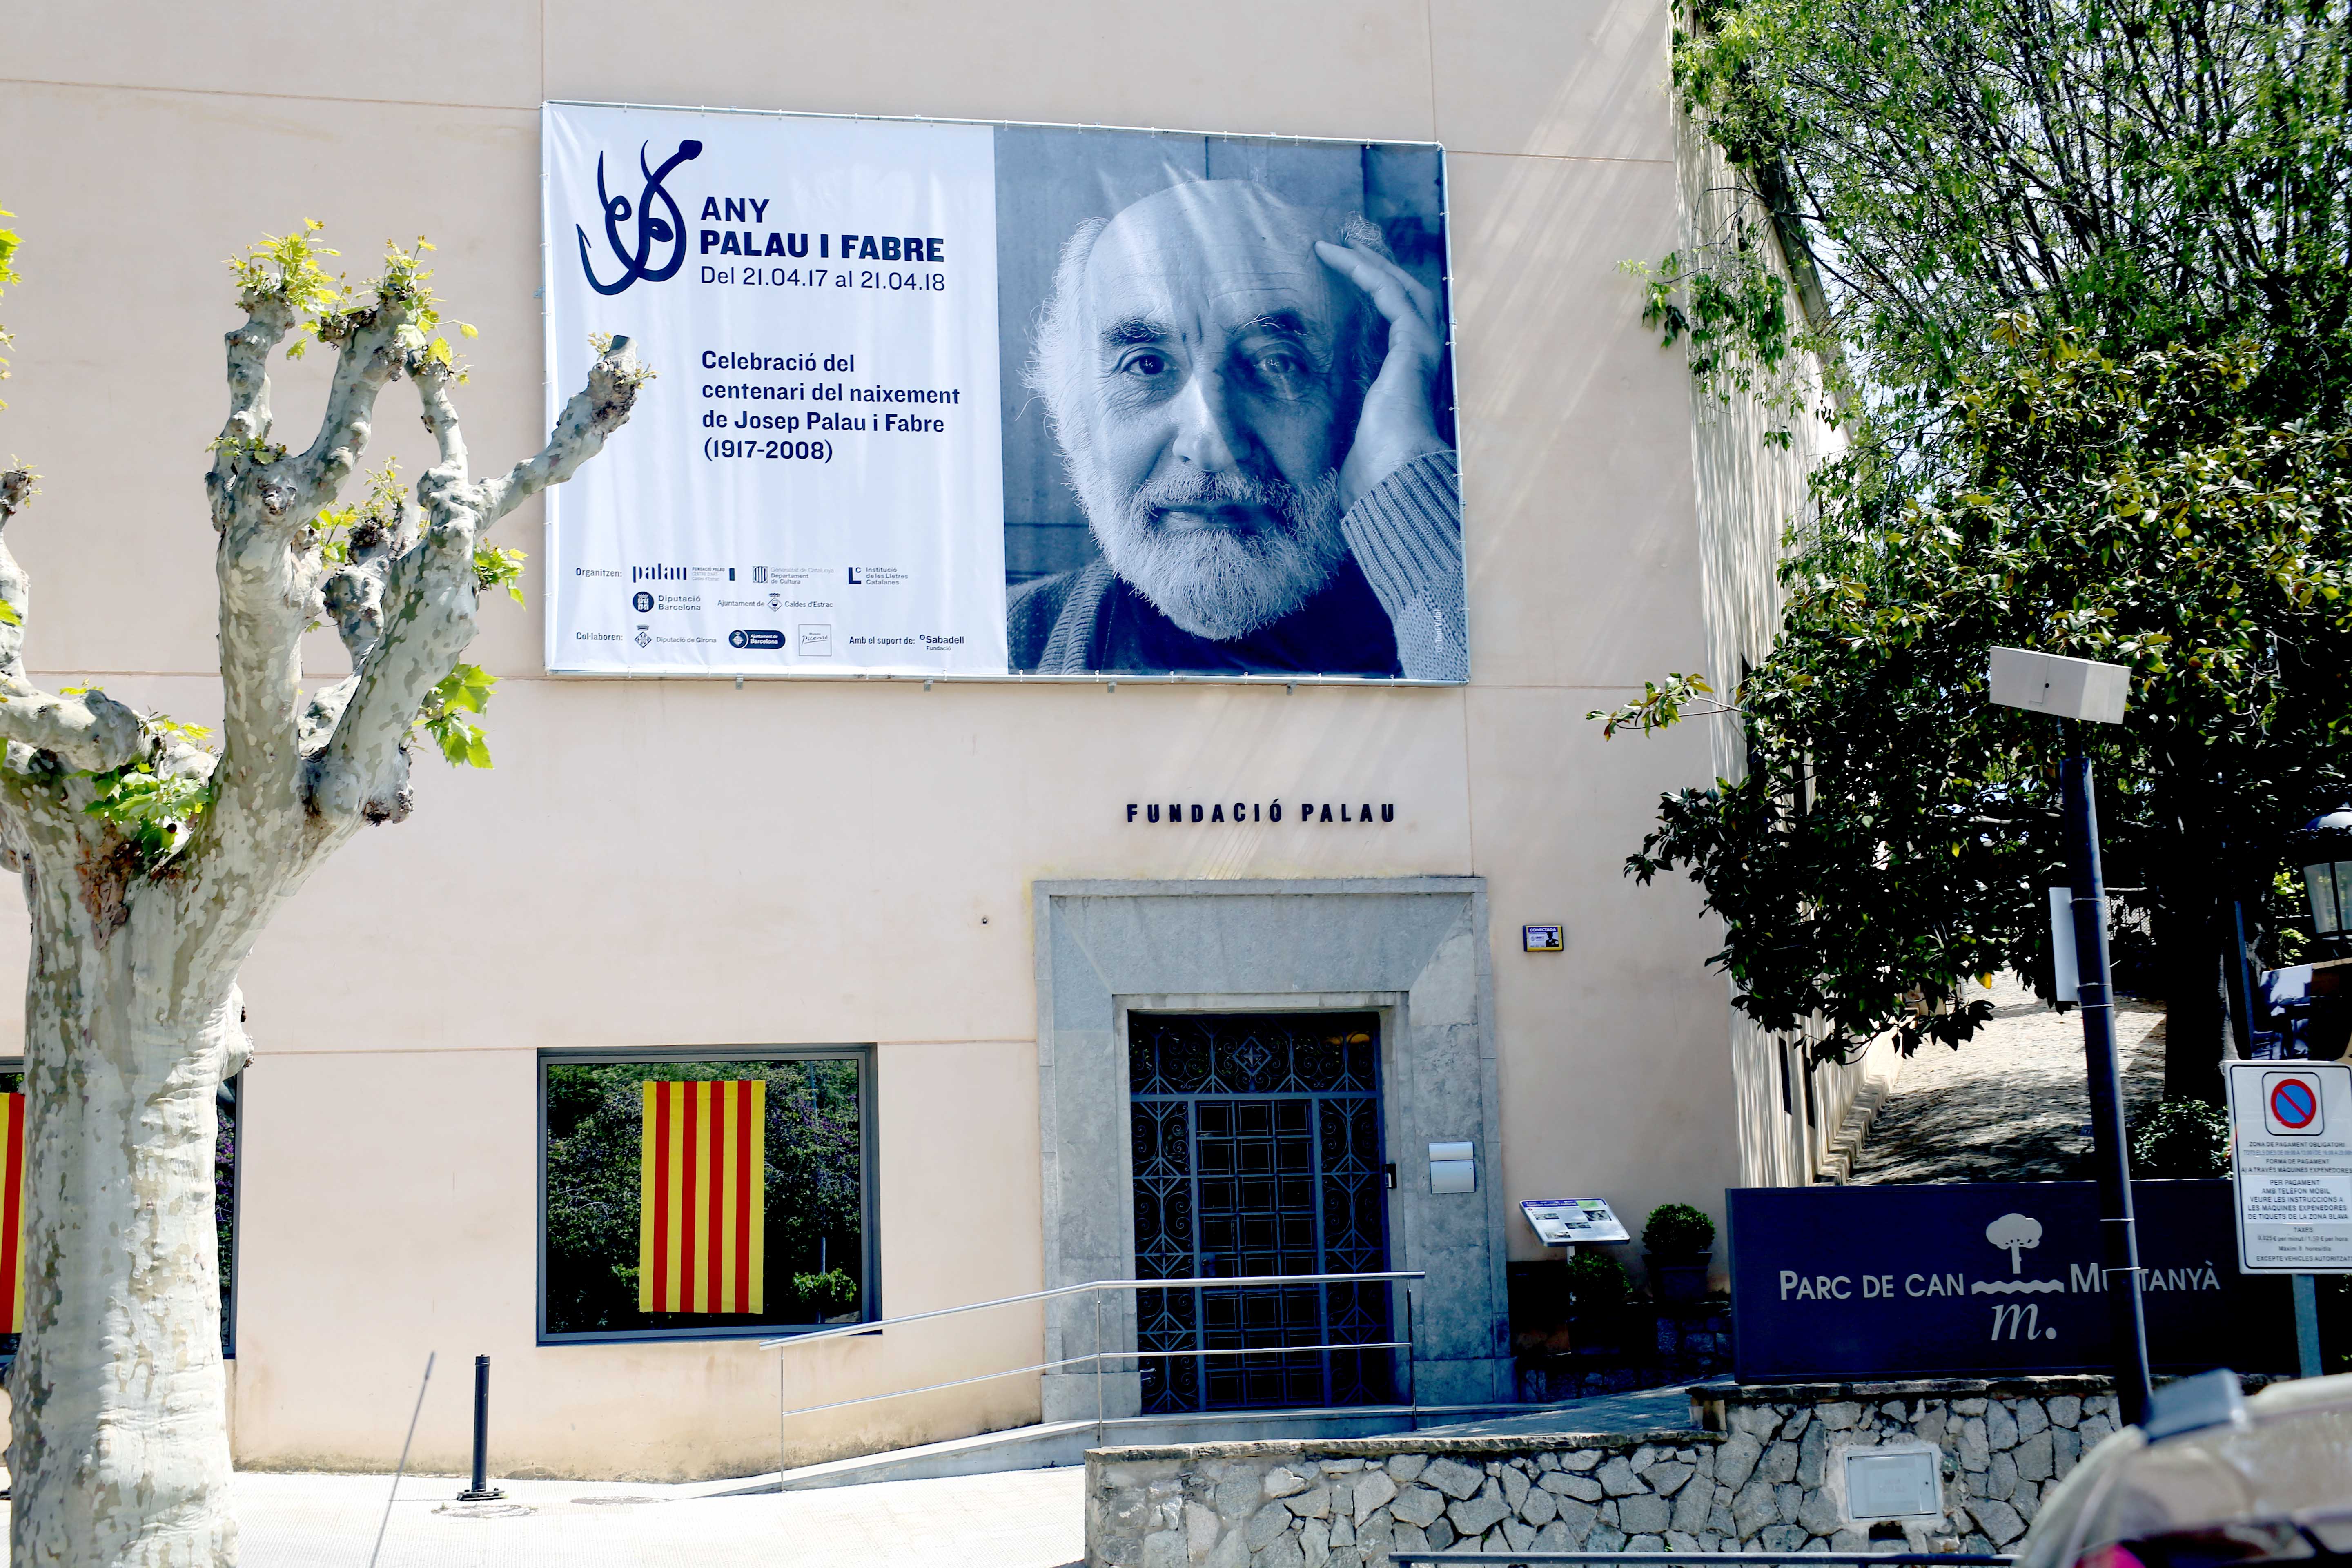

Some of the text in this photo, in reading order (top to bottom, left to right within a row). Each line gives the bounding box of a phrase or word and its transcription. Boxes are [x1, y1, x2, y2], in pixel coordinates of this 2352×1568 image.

[700, 196, 770, 223] ANY
[700, 230, 944, 263] PALAU I FABRE
[701, 266, 945, 291] Del 21.04.17 al 21.04.18
[702, 350, 855, 372] Celebració del
[702, 383, 960, 404] centenari del naixement
[702, 410, 944, 433] de Josep Palau i Fabre
[704, 437, 833, 464] (1917-2008)
[576, 568, 622, 577] Organitzen:
[633, 563, 686, 583] palau
[877, 637, 902, 646] suport
[926, 635, 964, 644] Sabadell
[1127, 799, 1394, 823] FUNDACIÓ PALAU
[2070, 1260, 2221, 1293] MTANYÀ
